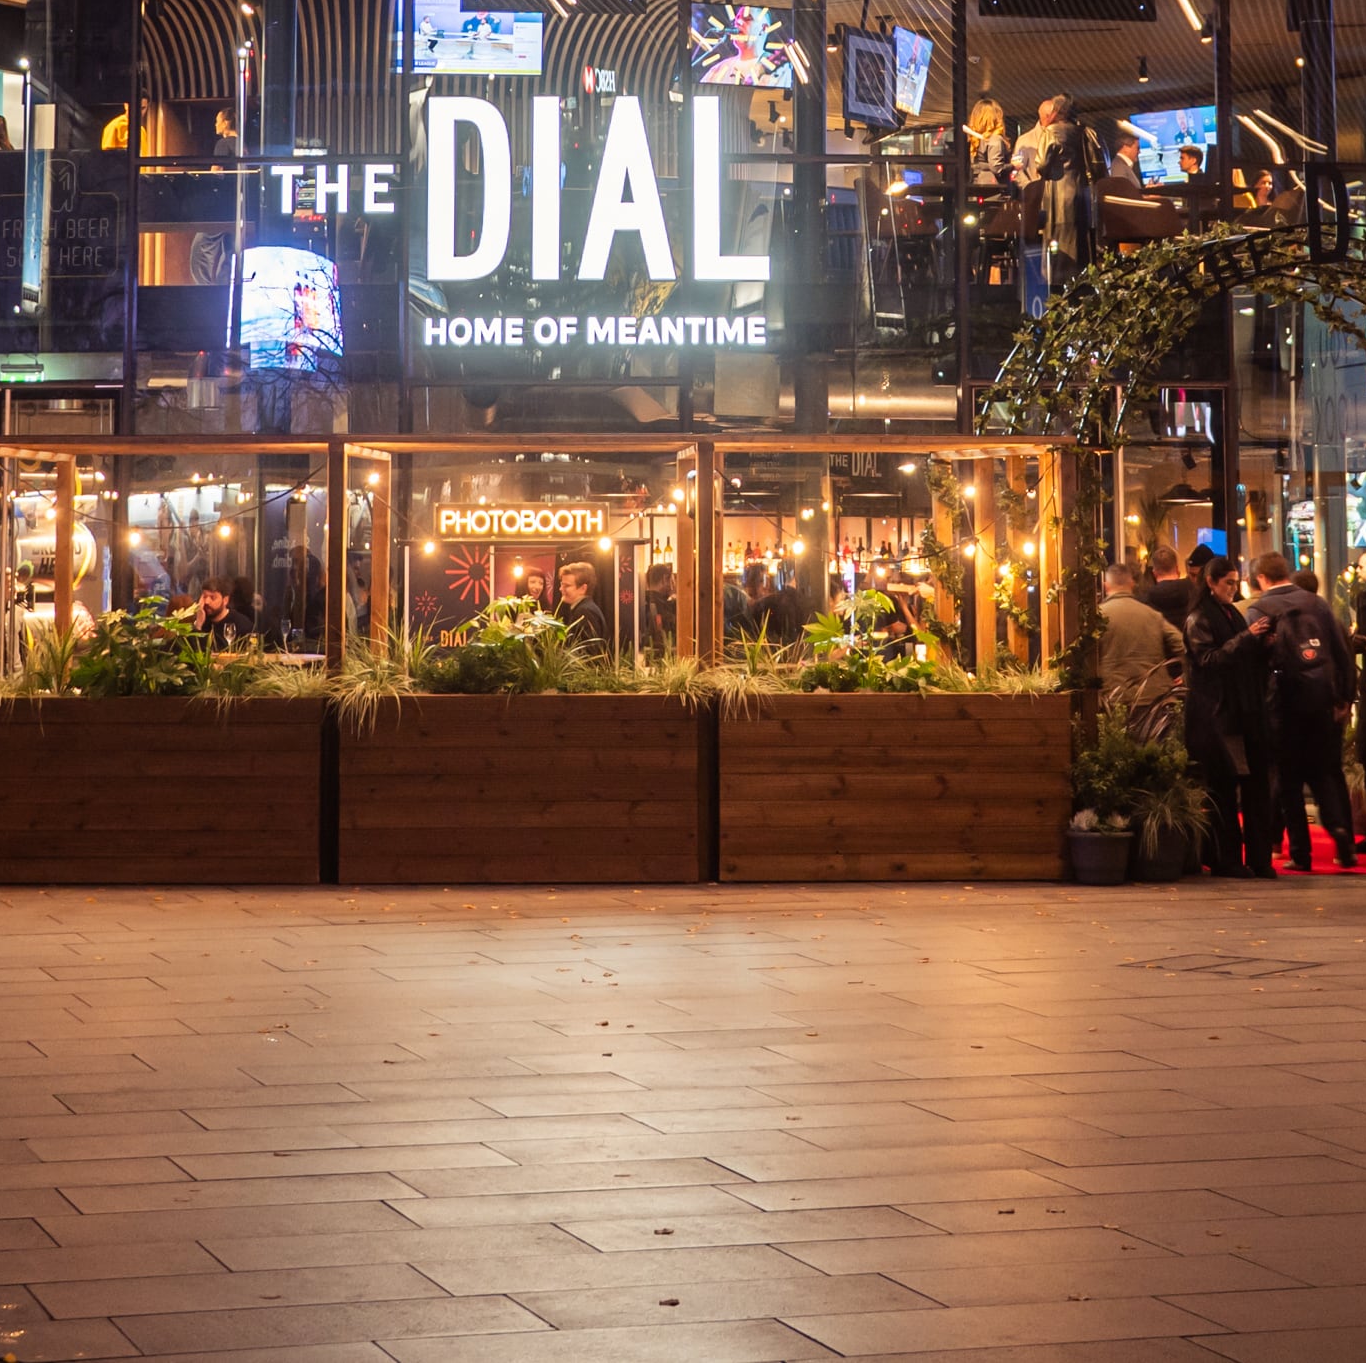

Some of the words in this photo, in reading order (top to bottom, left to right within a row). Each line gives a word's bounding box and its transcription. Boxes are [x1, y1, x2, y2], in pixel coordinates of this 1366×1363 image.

[271, 164, 395, 214] THE
[426, 95, 771, 281] DIAL
[67, 217, 109, 238] BEER
[60, 246, 103, 267] HERE
[424, 316, 523, 345] HOME
[534, 316, 578, 345] OF
[587, 316, 766, 345] MEANTIME
[830, 454, 848, 467] THE
[852, 451, 882, 477] DIAL
[440, 509, 603, 534] PHOTOBOOTH
